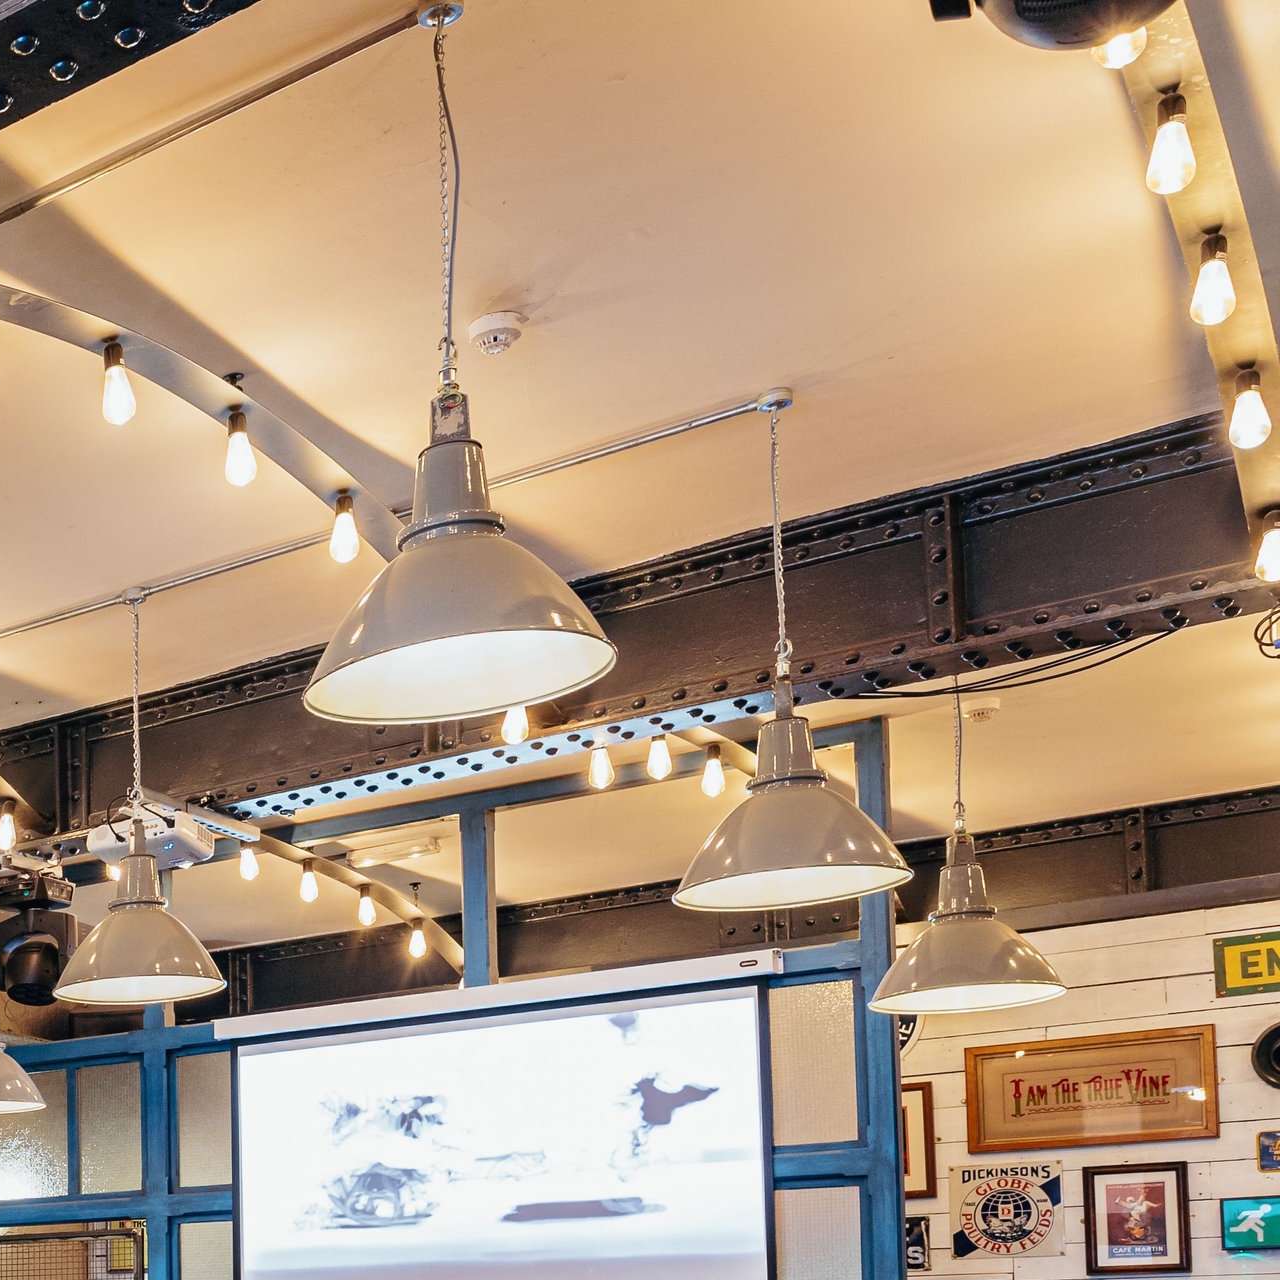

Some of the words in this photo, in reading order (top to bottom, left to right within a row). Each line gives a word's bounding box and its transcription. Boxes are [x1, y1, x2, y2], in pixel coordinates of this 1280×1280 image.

[1010, 1079, 1025, 1117] I
[1026, 1084, 1048, 1106] AM
[1052, 1079, 1081, 1104] THE
[1083, 1075, 1123, 1101] TRUE
[1120, 1068, 1171, 1104] VINE
[962, 1165, 1050, 1184] DICKINSON'S
[976, 1178, 1034, 1197] GLOBE
[962, 1213, 1013, 1253] POULTRY
[1019, 1209, 1053, 1250] FEEDS
